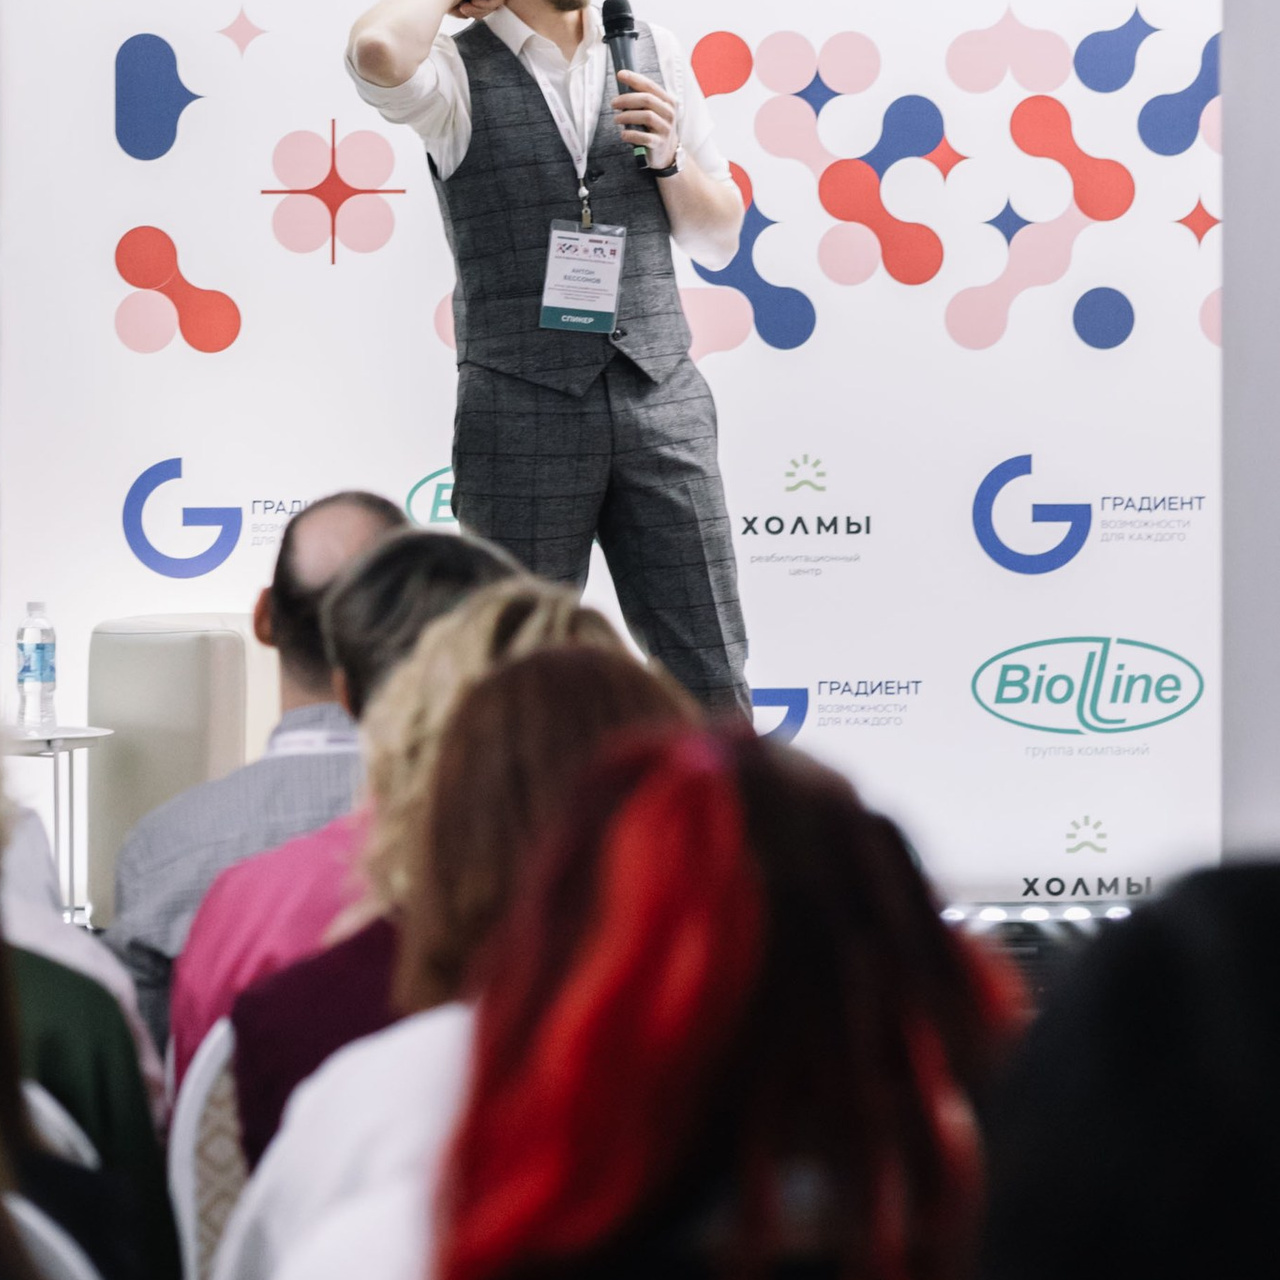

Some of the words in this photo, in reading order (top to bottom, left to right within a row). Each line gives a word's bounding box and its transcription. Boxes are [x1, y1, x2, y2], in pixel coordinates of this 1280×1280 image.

[561, 314, 595, 325] СПИКЕР
[252, 500, 316, 517] ГРАД
[1101, 496, 1206, 513] ГРАДИЕНТ
[741, 515, 871, 536] ХОЛМЫ
[1100, 519, 1191, 530] ВОЗМОЖНОСТИ
[1100, 532, 1123, 543] ДЛЯ
[1128, 532, 1186, 543] КАЖДОГО
[750, 552, 861, 564] реабилитационный
[788, 567, 822, 577] центр
[818, 680, 923, 697] ГРАДИЕНТ
[817, 703, 908, 714] ВОЗМОЖНОСТИ
[817, 716, 841, 727] ДЛЯ
[845, 716, 903, 727] КАЖДОГО
[1025, 745, 1074, 758] группа
[1077, 742, 1150, 757] компаний
[1022, 877, 1152, 897] ХОЛМЫ
